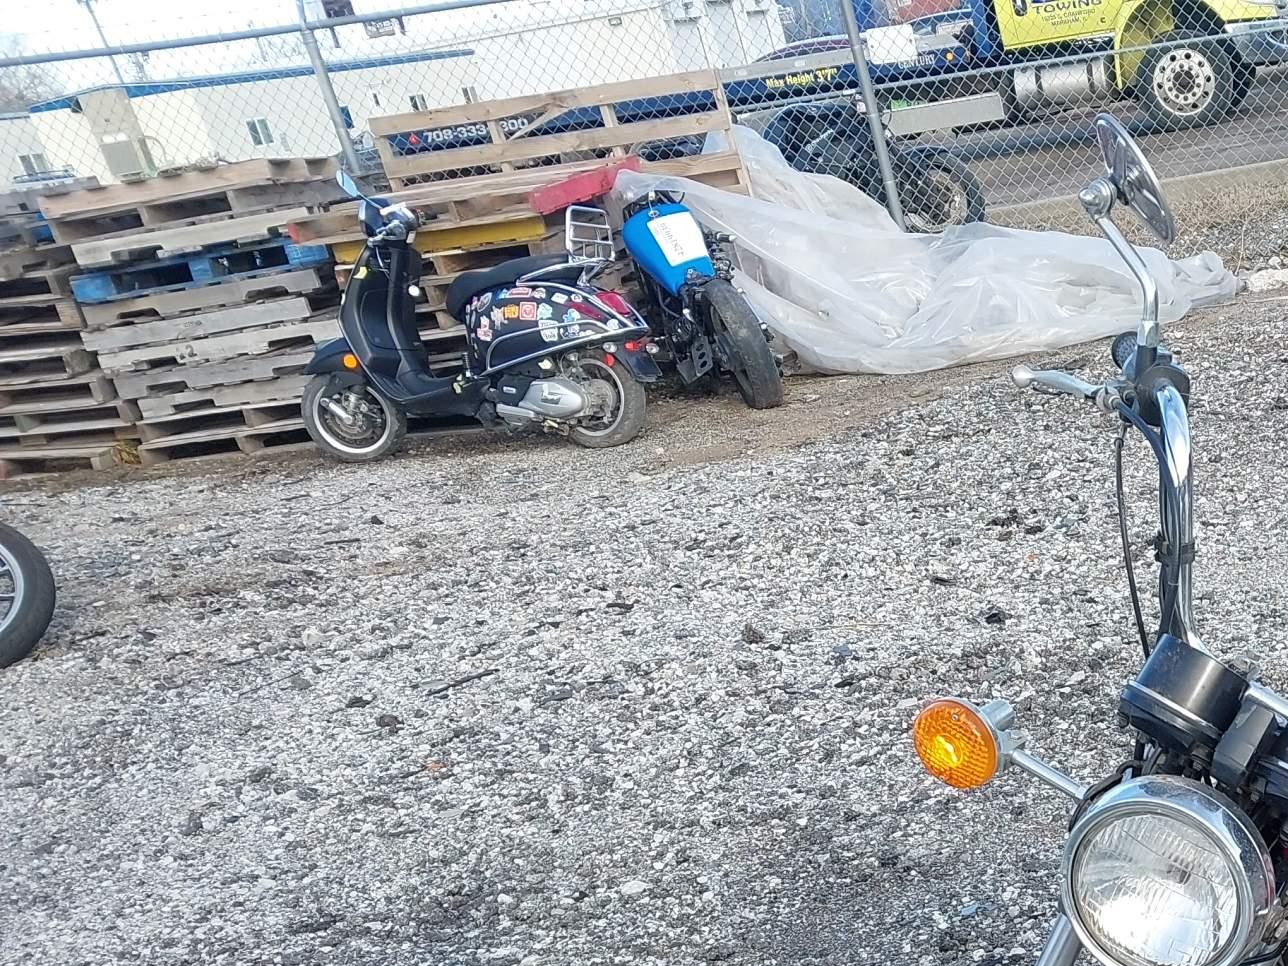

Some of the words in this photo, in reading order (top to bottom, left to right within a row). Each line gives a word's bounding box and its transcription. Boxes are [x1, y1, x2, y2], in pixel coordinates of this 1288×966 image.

[897, 53, 935, 69] CENTURY
[766, 78, 785, 88] Max
[785, 72, 815, 86] Height
